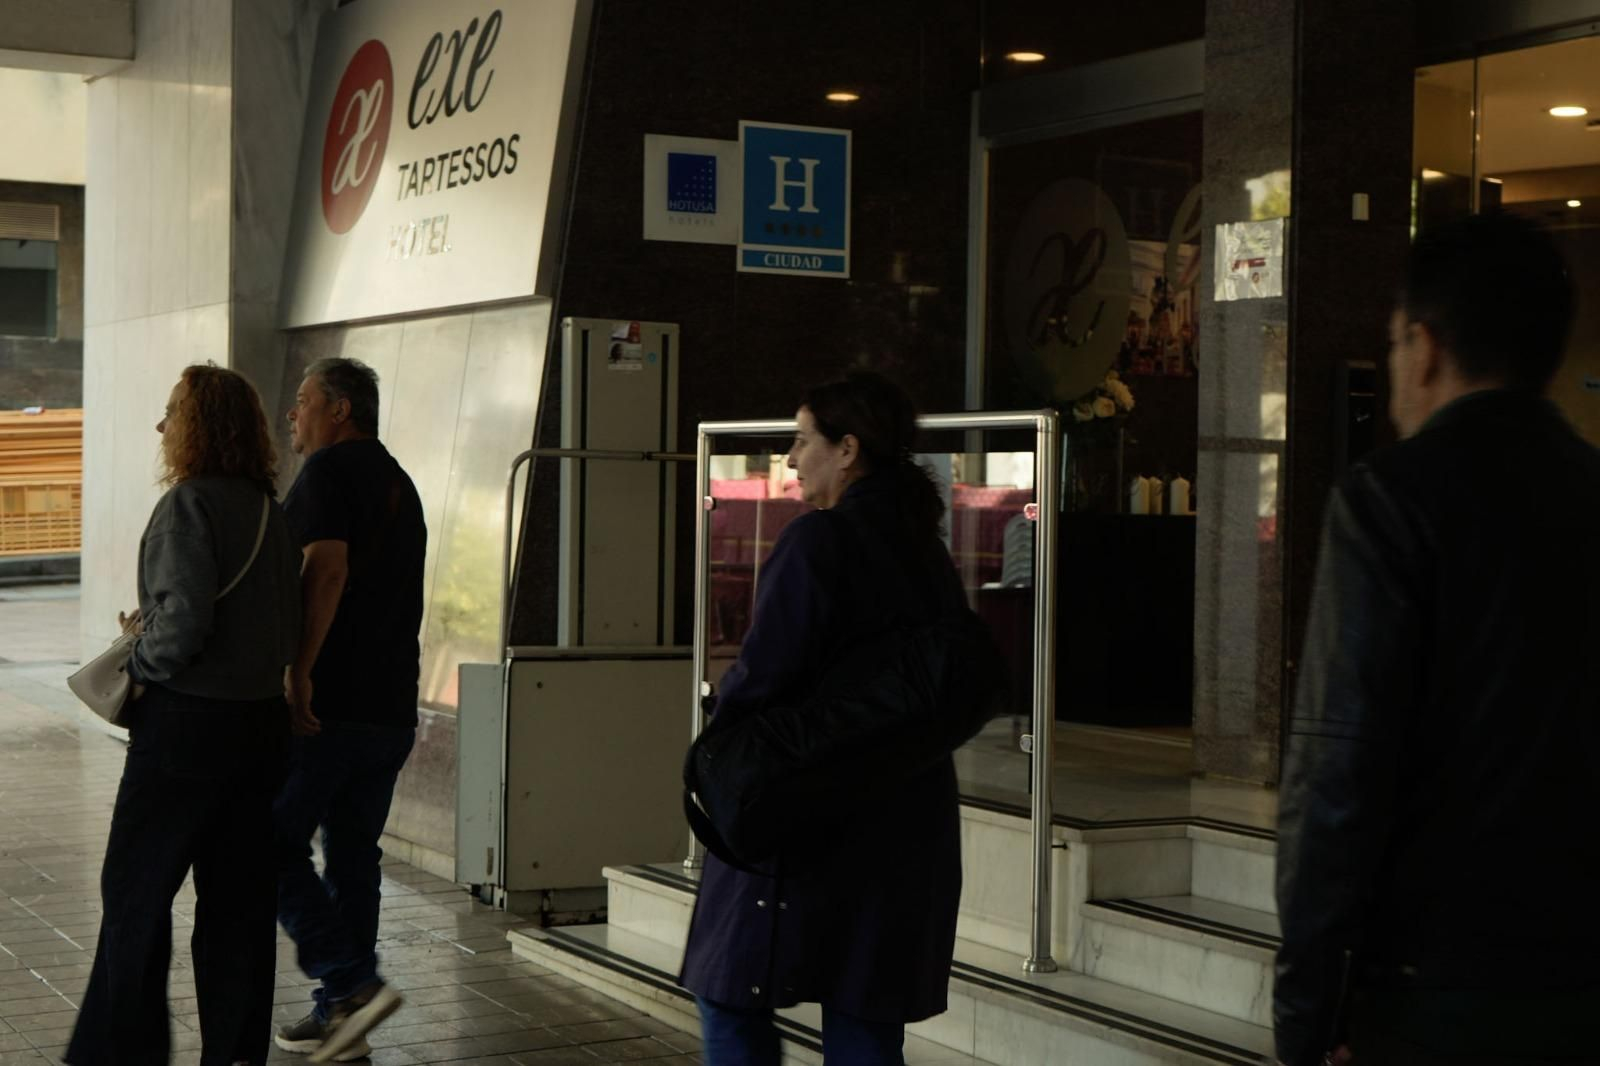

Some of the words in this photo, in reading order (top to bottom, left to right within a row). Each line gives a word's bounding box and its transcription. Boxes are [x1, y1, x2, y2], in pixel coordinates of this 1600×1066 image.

[408, 9, 502, 129] exe
[397, 133, 520, 201] TARTESSOS
[768, 155, 821, 213] H
[669, 199, 715, 212] HOTUSA
[385, 213, 452, 263] HOTEL
[763, 253, 823, 269] CIUDAD
